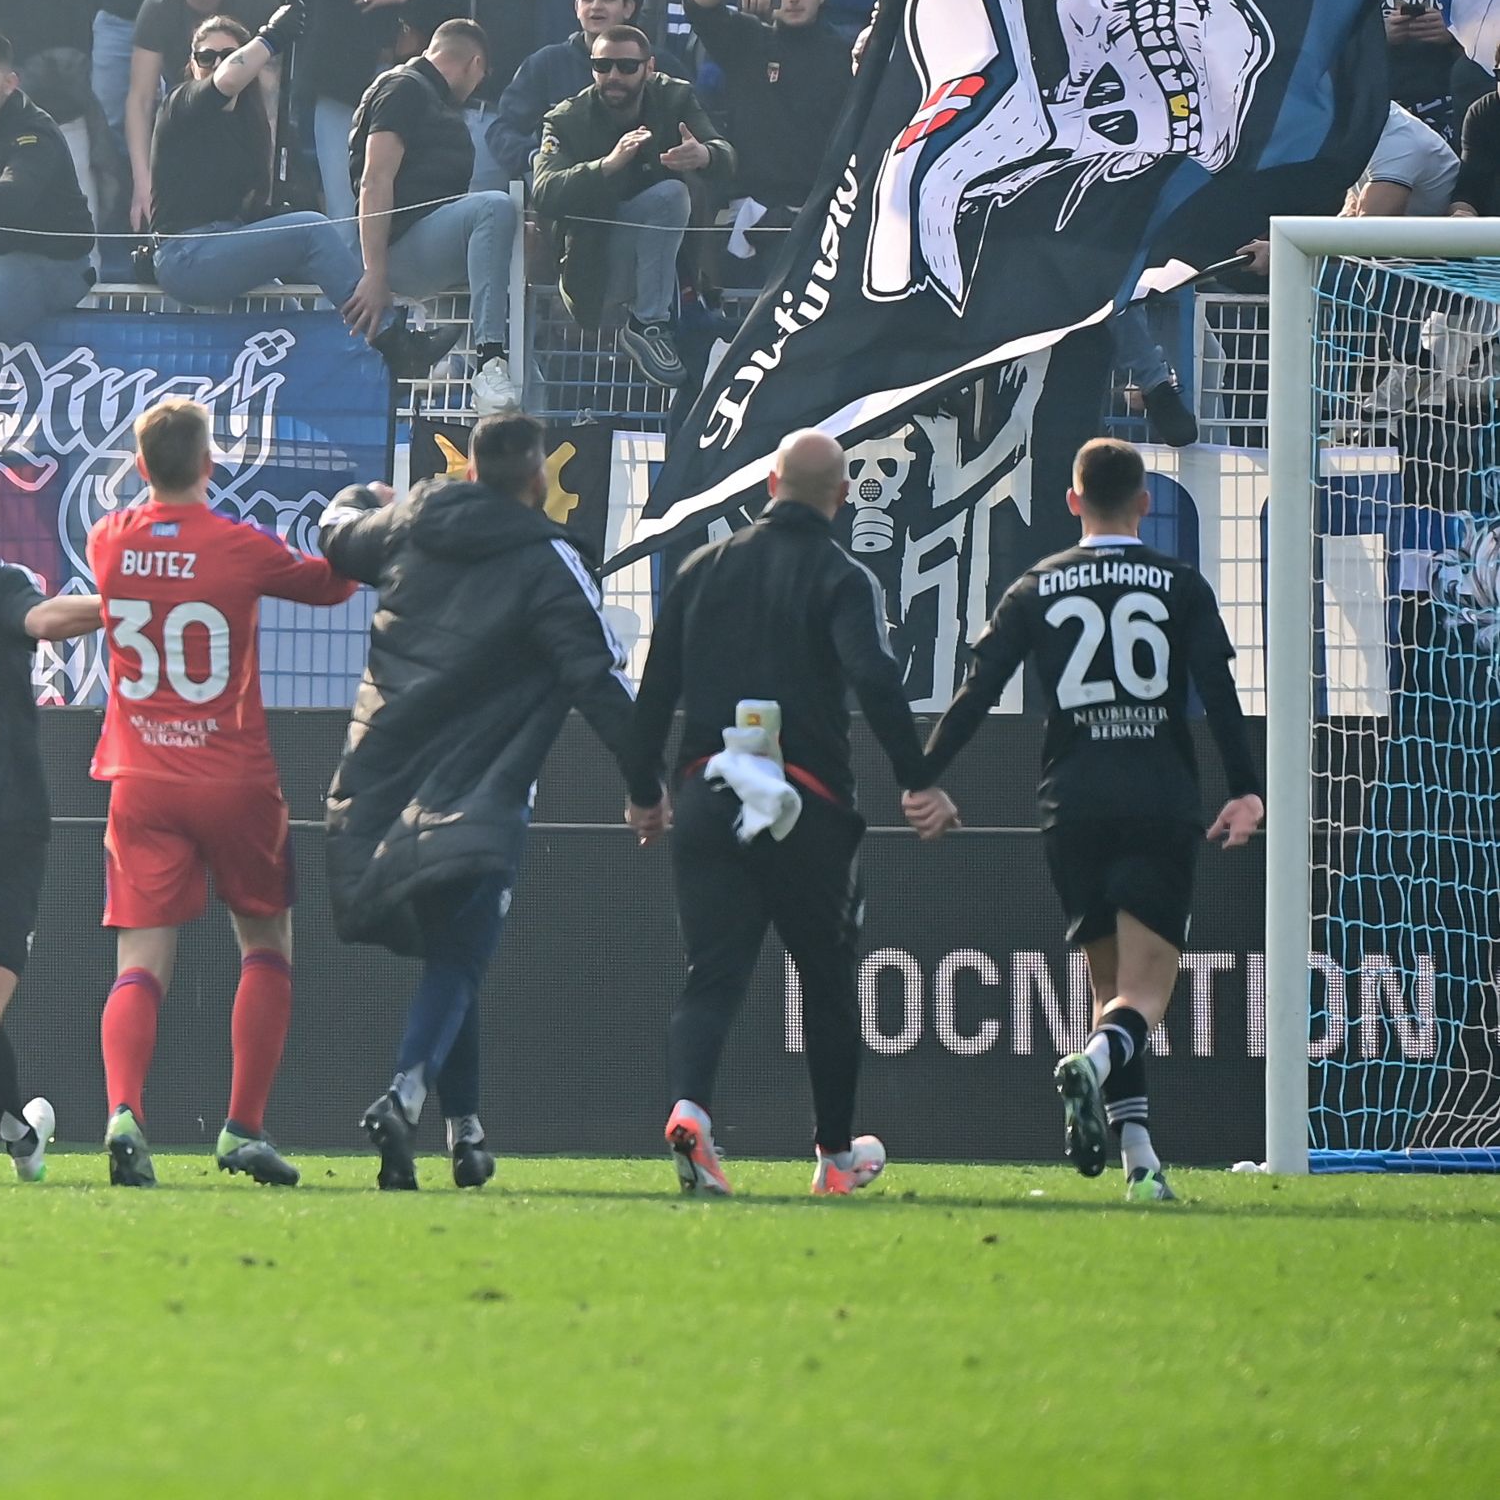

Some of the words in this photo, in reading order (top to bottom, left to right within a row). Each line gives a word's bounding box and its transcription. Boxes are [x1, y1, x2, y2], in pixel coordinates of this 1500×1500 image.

[121, 549, 198, 580] BUTEZ
[1038, 559, 1174, 597] ENGELHARDT
[107, 597, 231, 704] 30
[1044, 590, 1171, 711] 26
